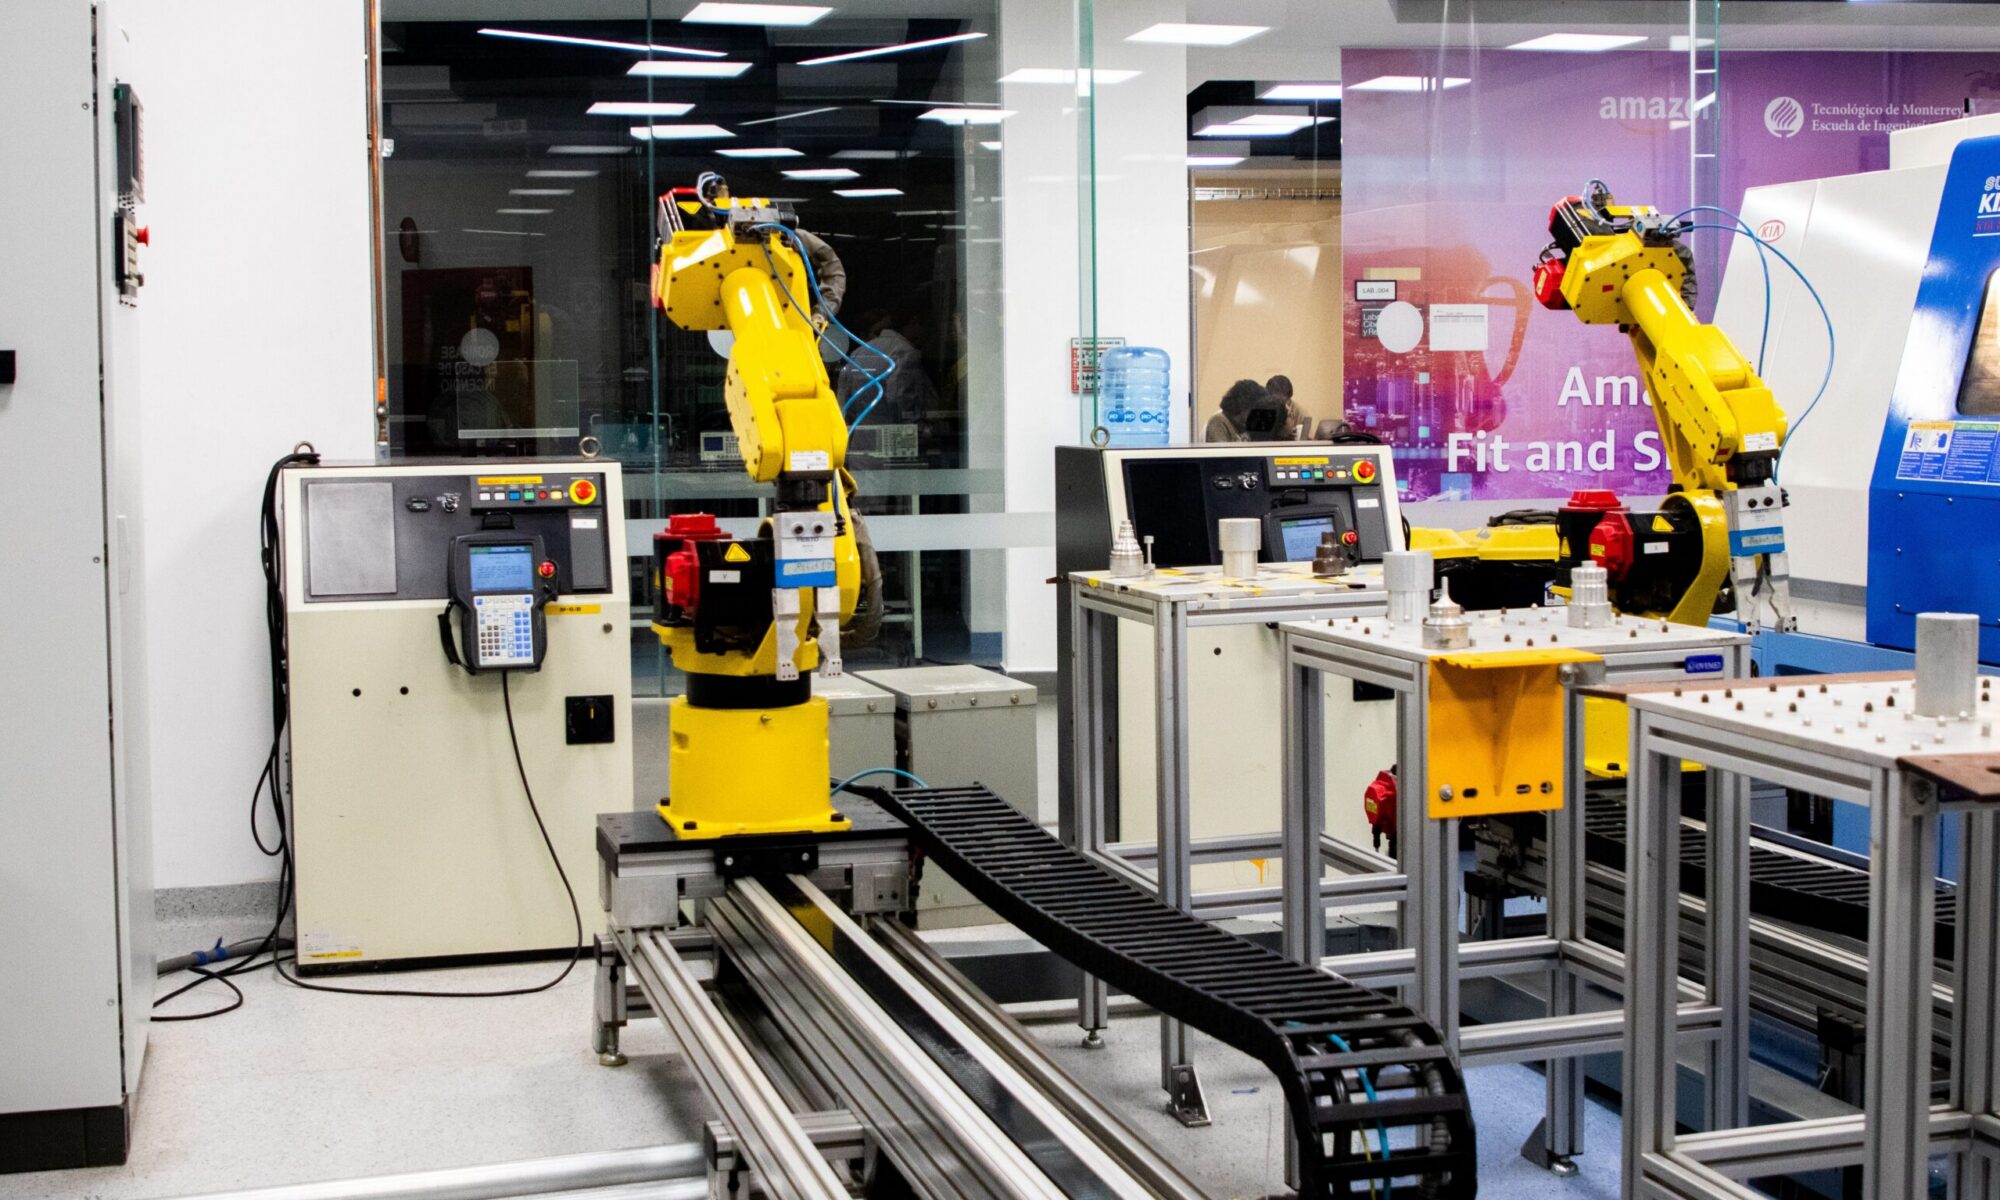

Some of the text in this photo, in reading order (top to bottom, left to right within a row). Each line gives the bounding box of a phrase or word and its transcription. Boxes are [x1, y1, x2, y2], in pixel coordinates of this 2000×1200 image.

[1811, 102, 1883, 117] Tecnológico
[1885, 104, 1900, 116] de
[1811, 120, 1855, 132] Escuela
[1861, 120, 1871, 131] de
[1761, 224, 1780, 238] KIA
[1447, 429, 1673, 472] Fit and S
